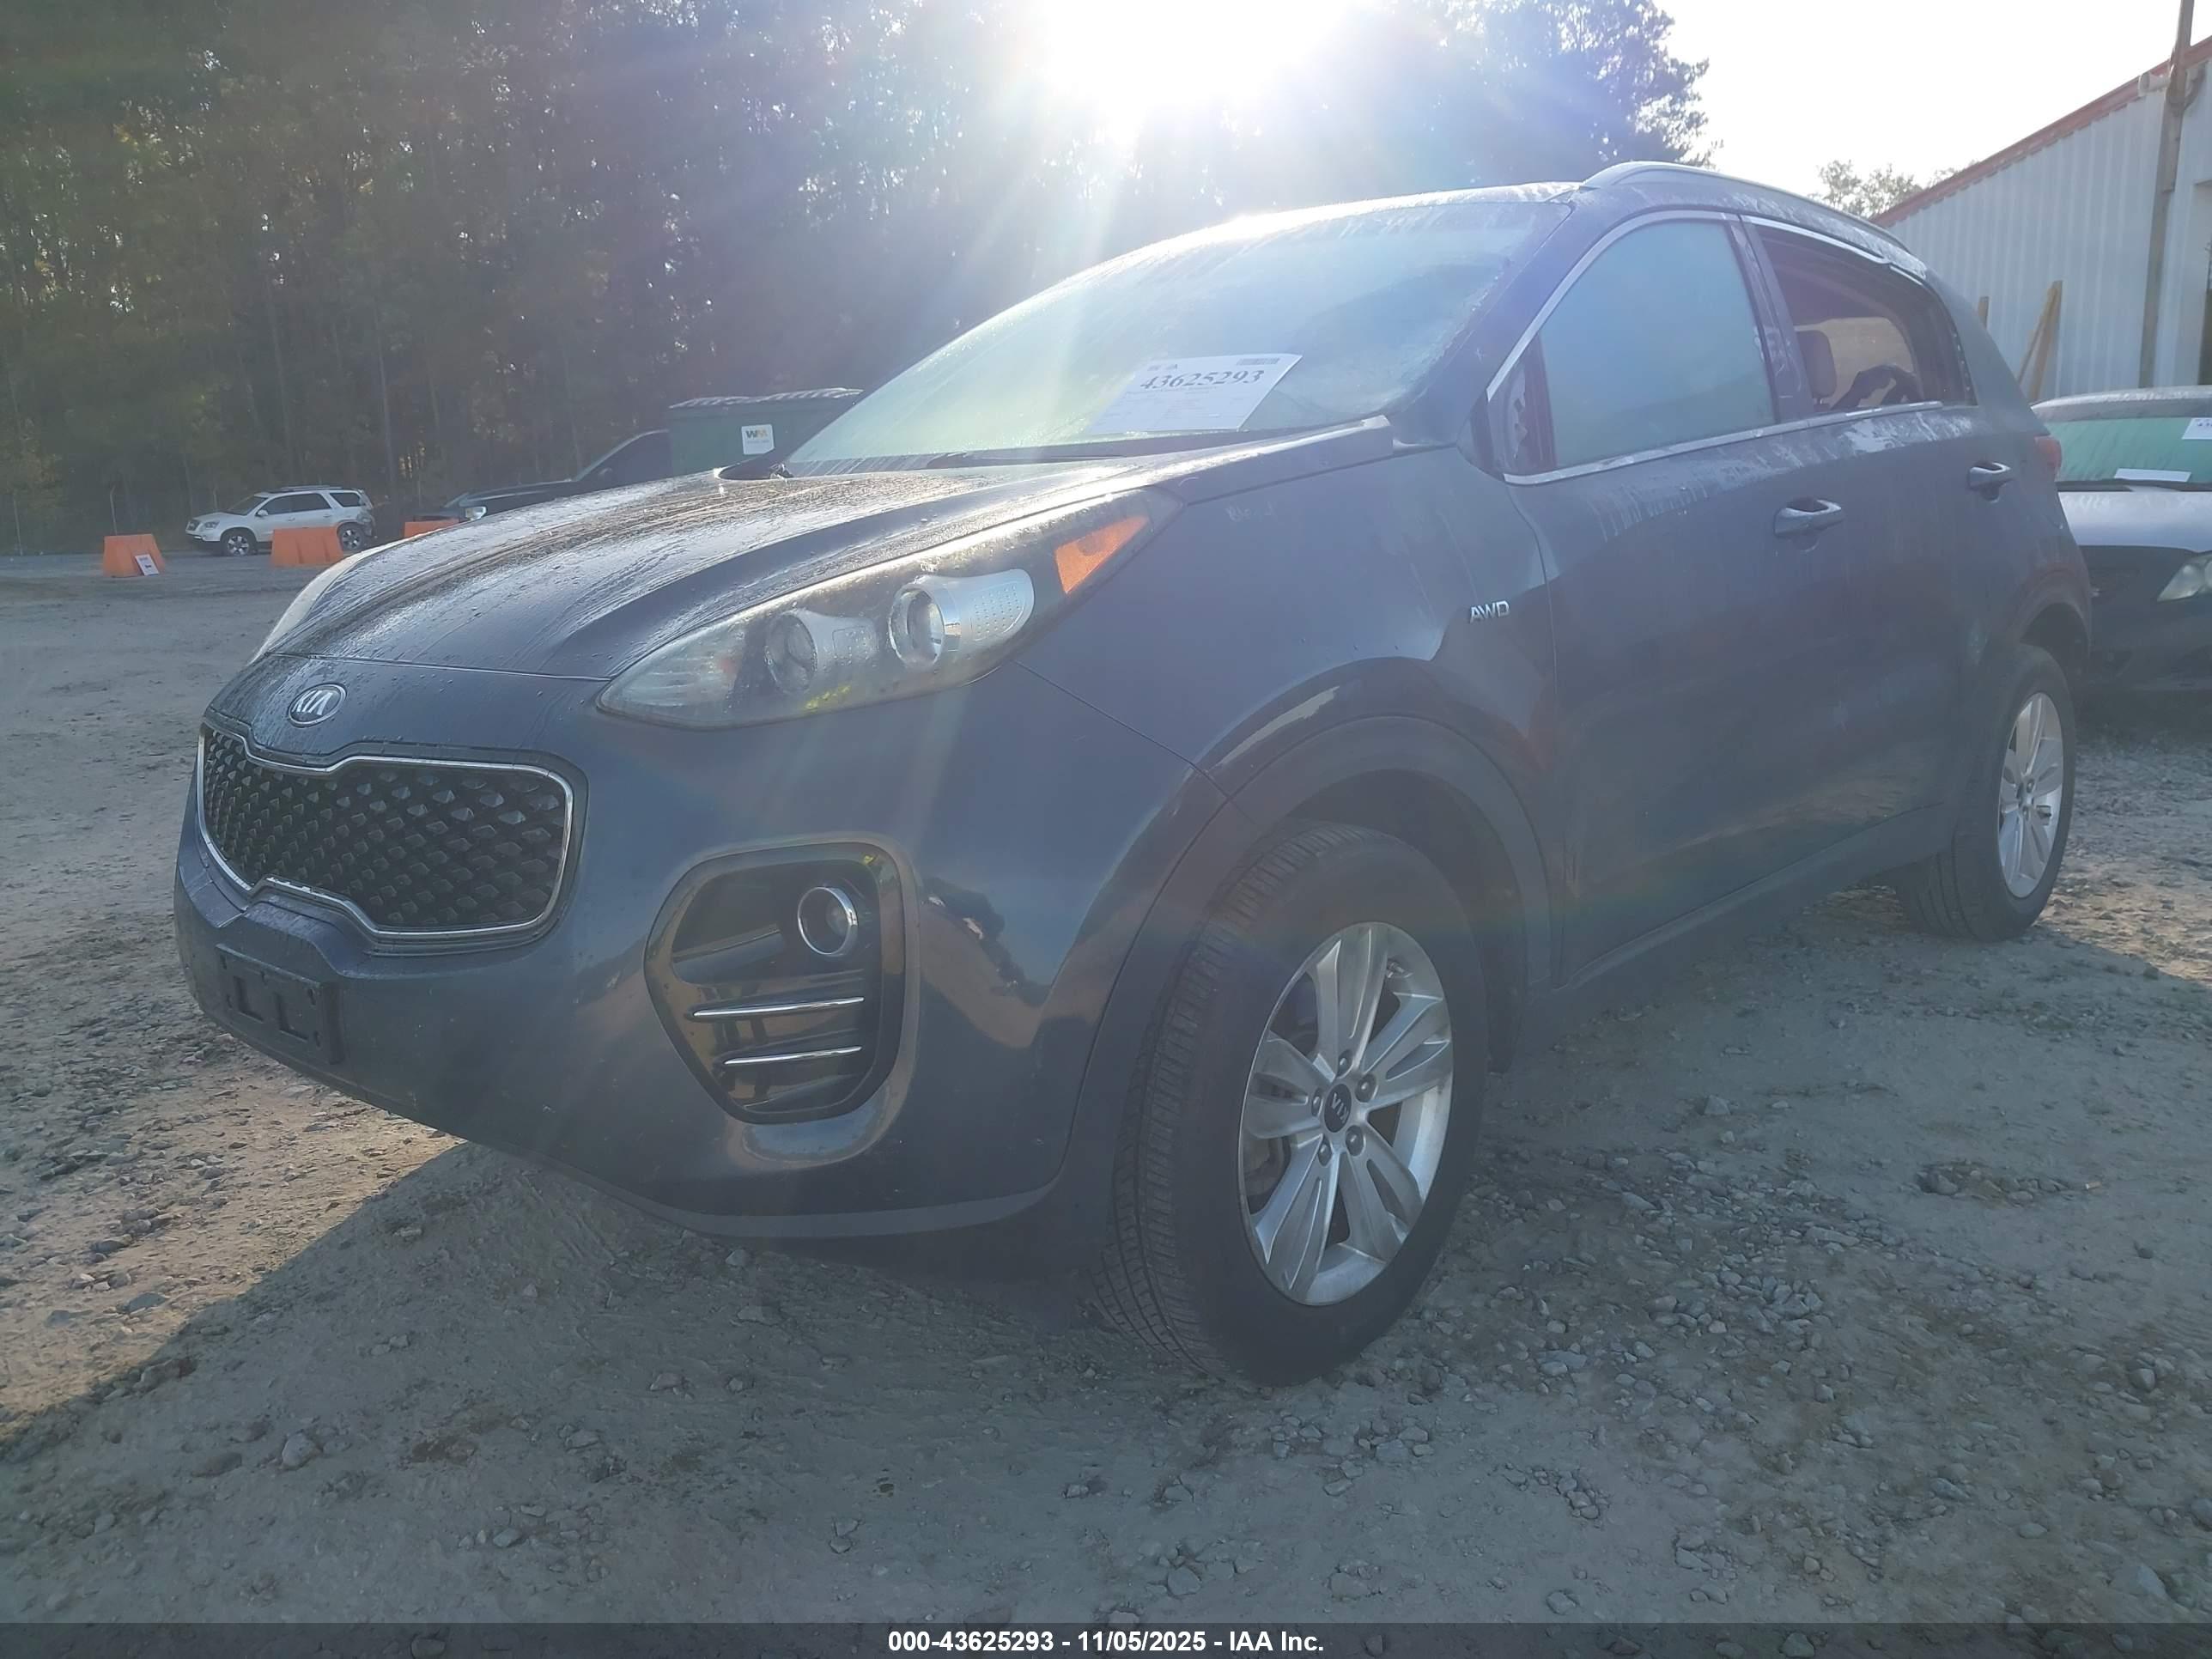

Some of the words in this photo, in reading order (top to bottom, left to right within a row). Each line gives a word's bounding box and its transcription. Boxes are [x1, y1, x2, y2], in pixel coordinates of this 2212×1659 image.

[1140, 370, 1265, 389] 43625293
[1469, 600, 1510, 624] AWD
[291, 690, 334, 716] KIA
[1331, 1092, 1350, 1124] KIA
